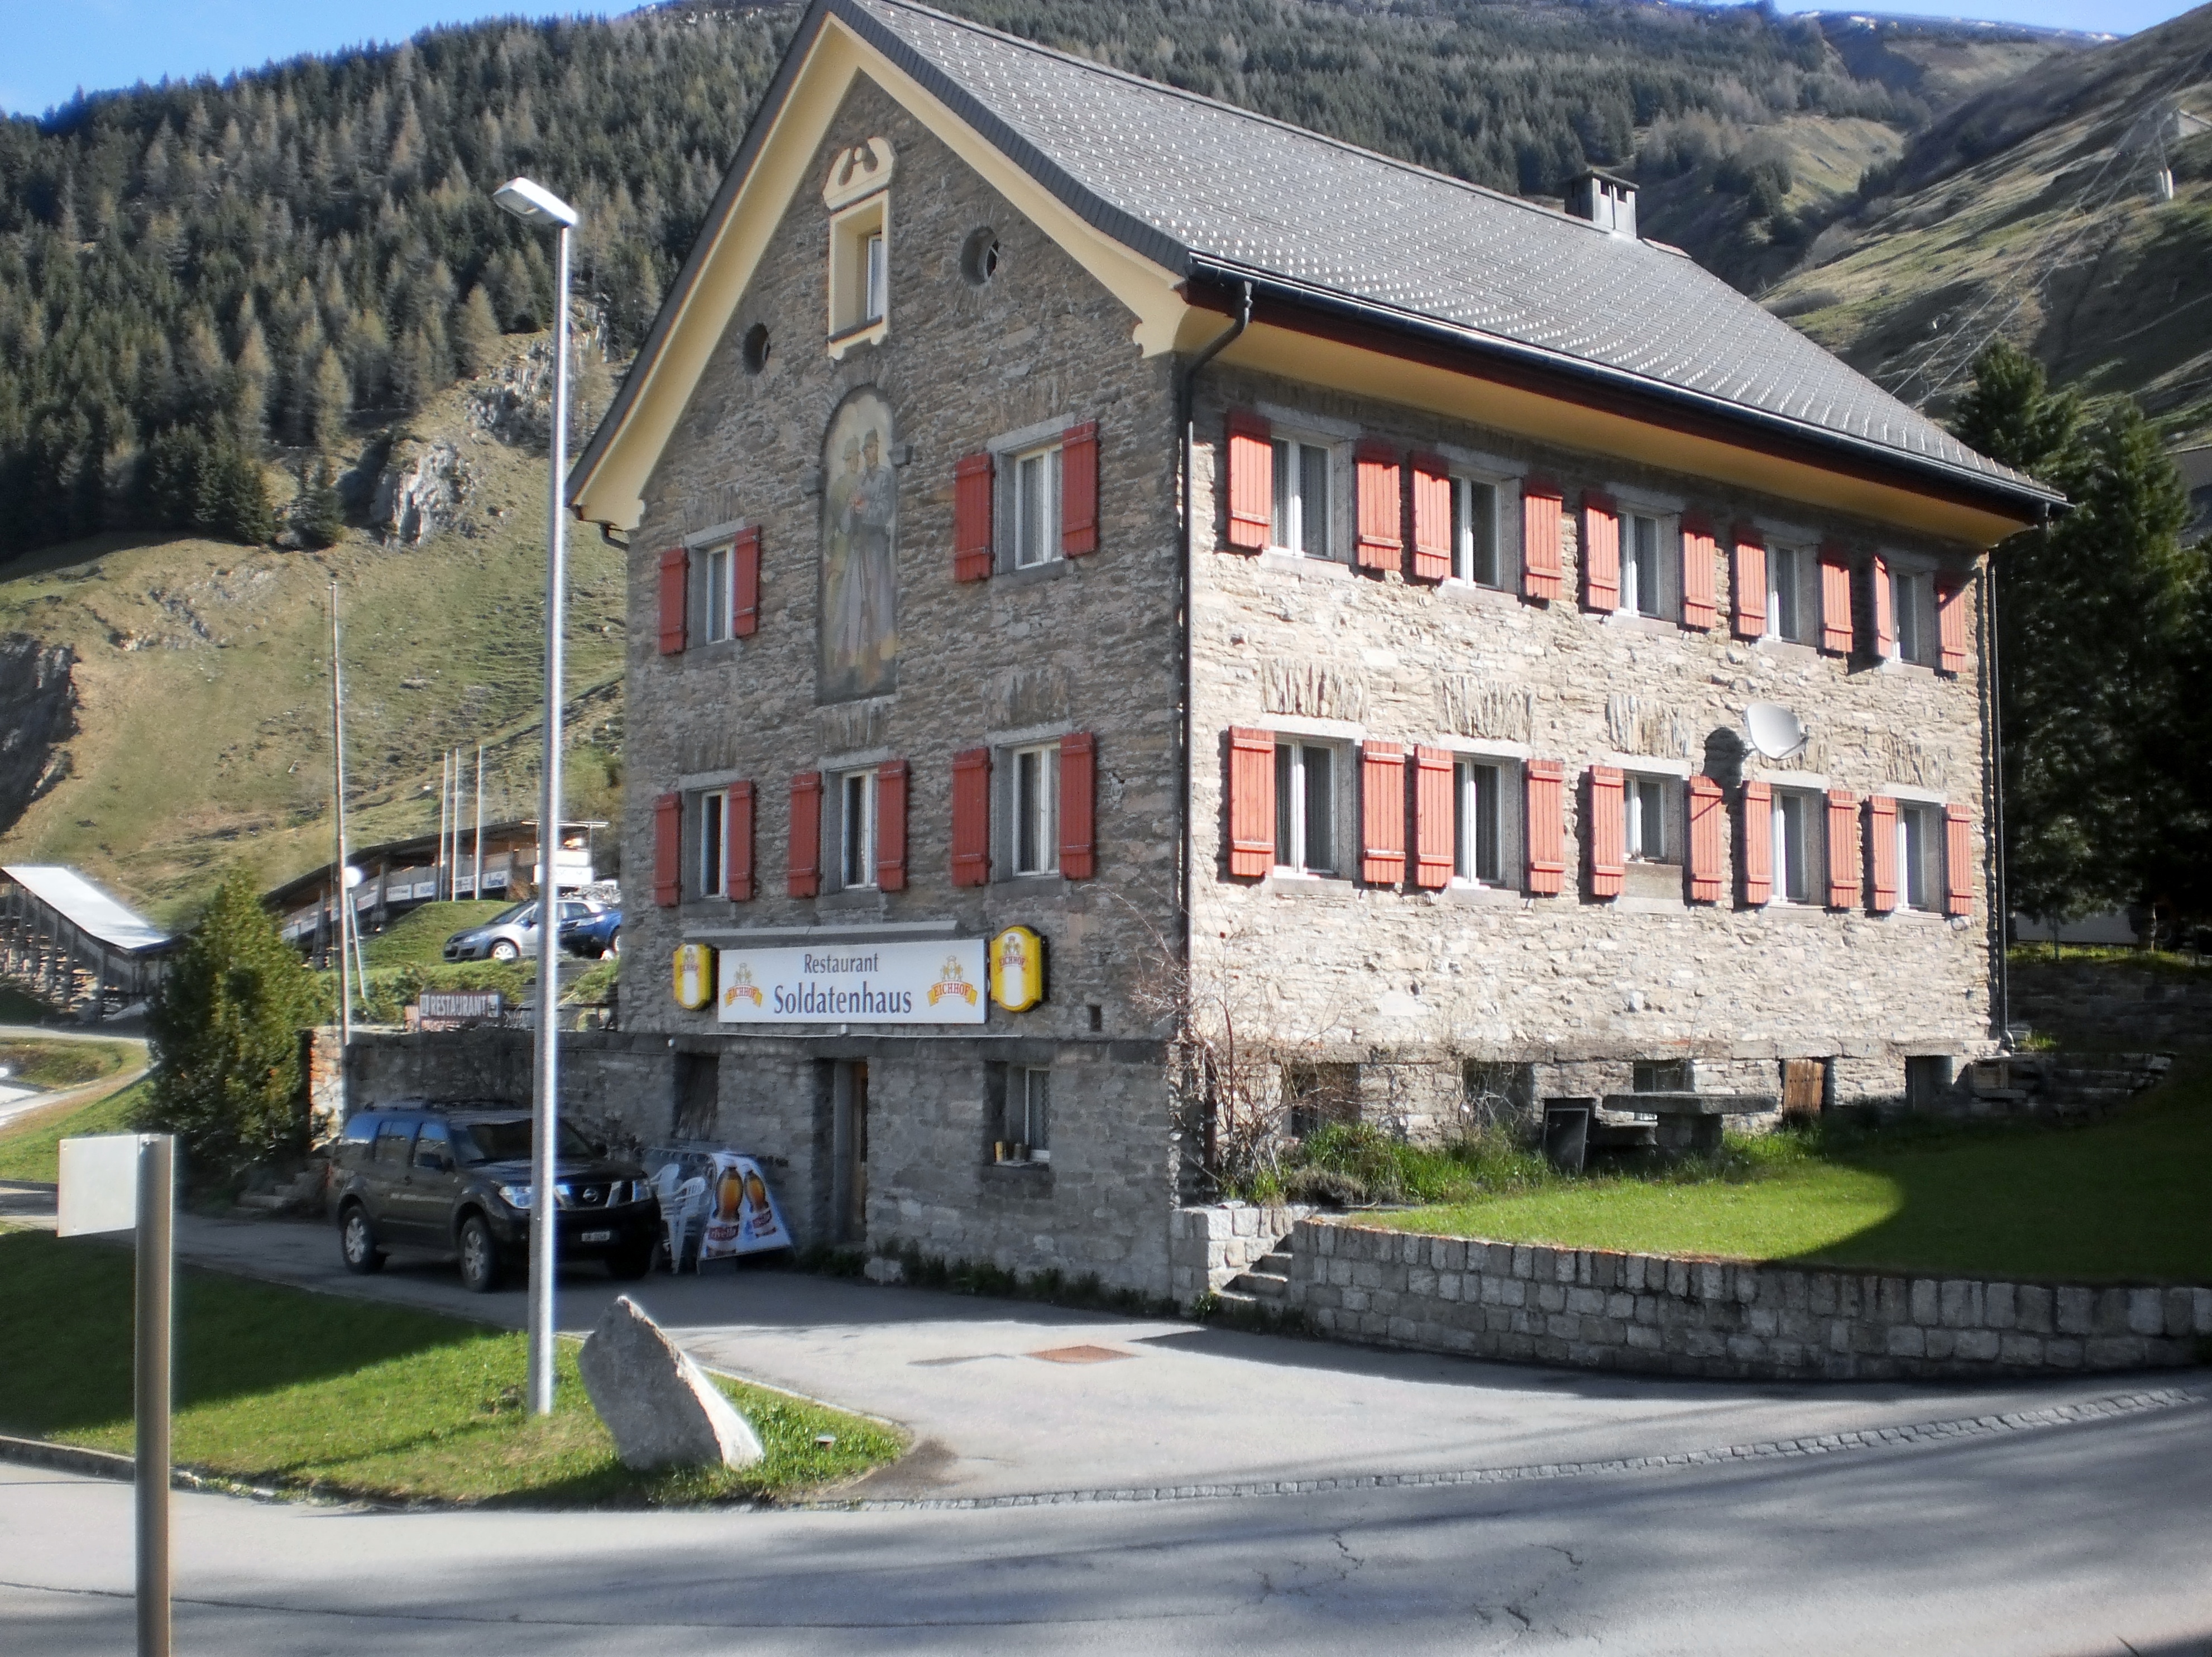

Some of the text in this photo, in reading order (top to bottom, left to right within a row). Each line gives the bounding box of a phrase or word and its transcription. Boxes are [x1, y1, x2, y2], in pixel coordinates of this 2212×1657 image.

[804, 952, 879, 973] Restaurant
[999, 955, 1026, 966] EICHHOF
[728, 986, 757, 999] EICHHOF
[774, 981, 912, 1014] Soldatenhaus
[933, 983, 971, 997] EICHHOF
[430, 995, 486, 1016] RESTAURANT
